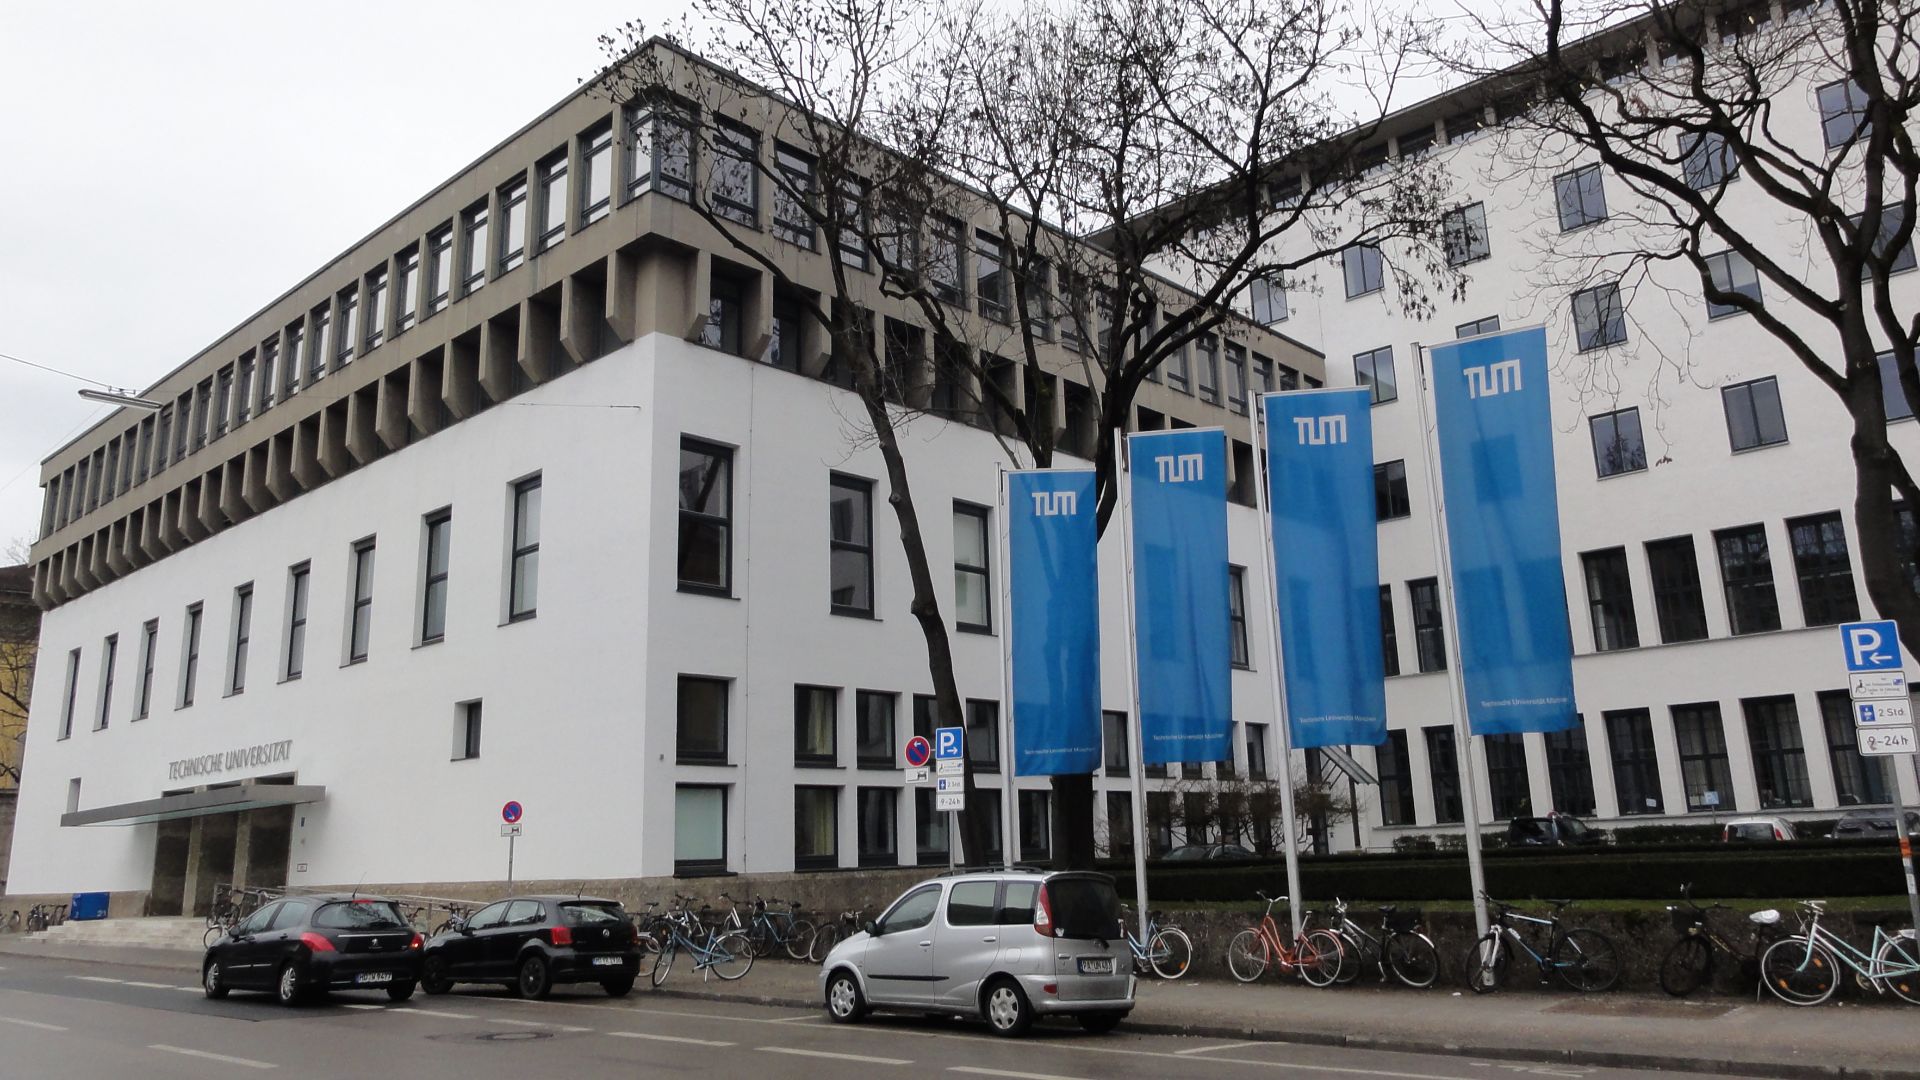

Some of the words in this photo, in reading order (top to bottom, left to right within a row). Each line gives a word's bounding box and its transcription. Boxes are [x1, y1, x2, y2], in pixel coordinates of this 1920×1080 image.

[1463, 358, 1522, 399] TUM
[1293, 414, 1347, 445] TUM
[1154, 453, 1203, 483] TUM
[1031, 491, 1077, 516] TUM
[1849, 628, 1882, 666] P
[1878, 708, 1885, 717] 2
[940, 732, 955, 756] P
[168, 752, 224, 780] TECHNISCHE
[225, 739, 293, 770] UNIVERSITÄT
